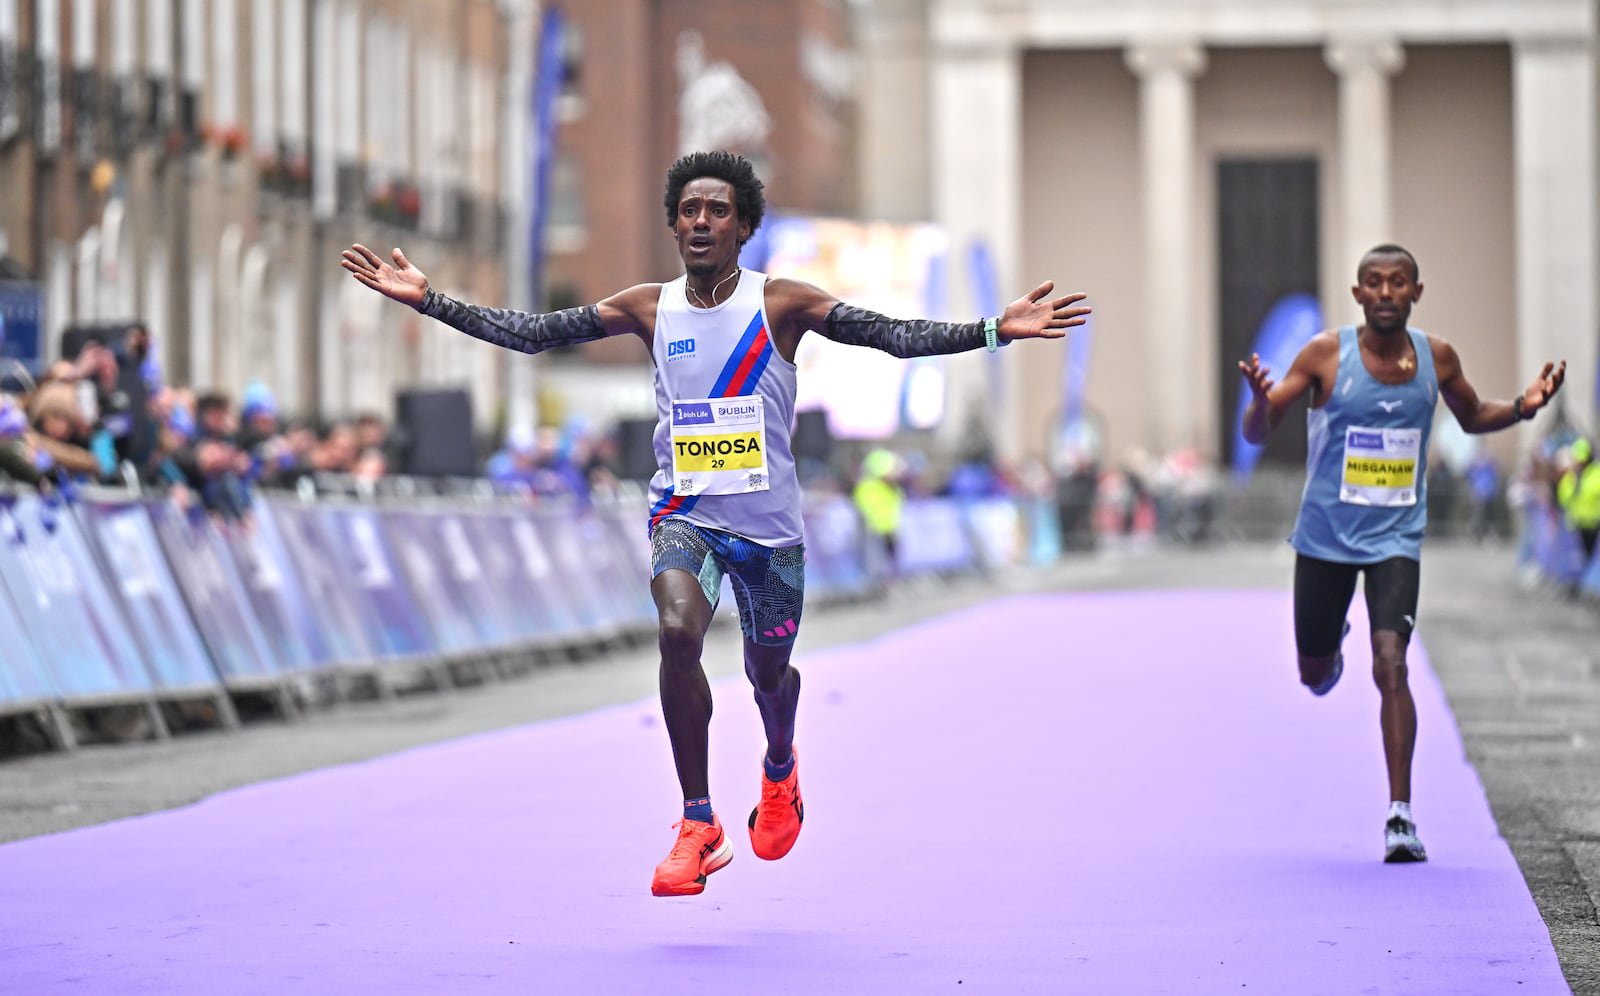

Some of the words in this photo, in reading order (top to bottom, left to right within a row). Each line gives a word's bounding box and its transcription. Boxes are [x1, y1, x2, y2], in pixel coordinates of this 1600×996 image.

[668, 338, 695, 357] DSD
[718, 405, 755, 415] DUBLIN
[675, 437, 760, 456] TONOSA
[711, 459, 725, 469] 29
[1347, 461, 1413, 474] MISGANAW
